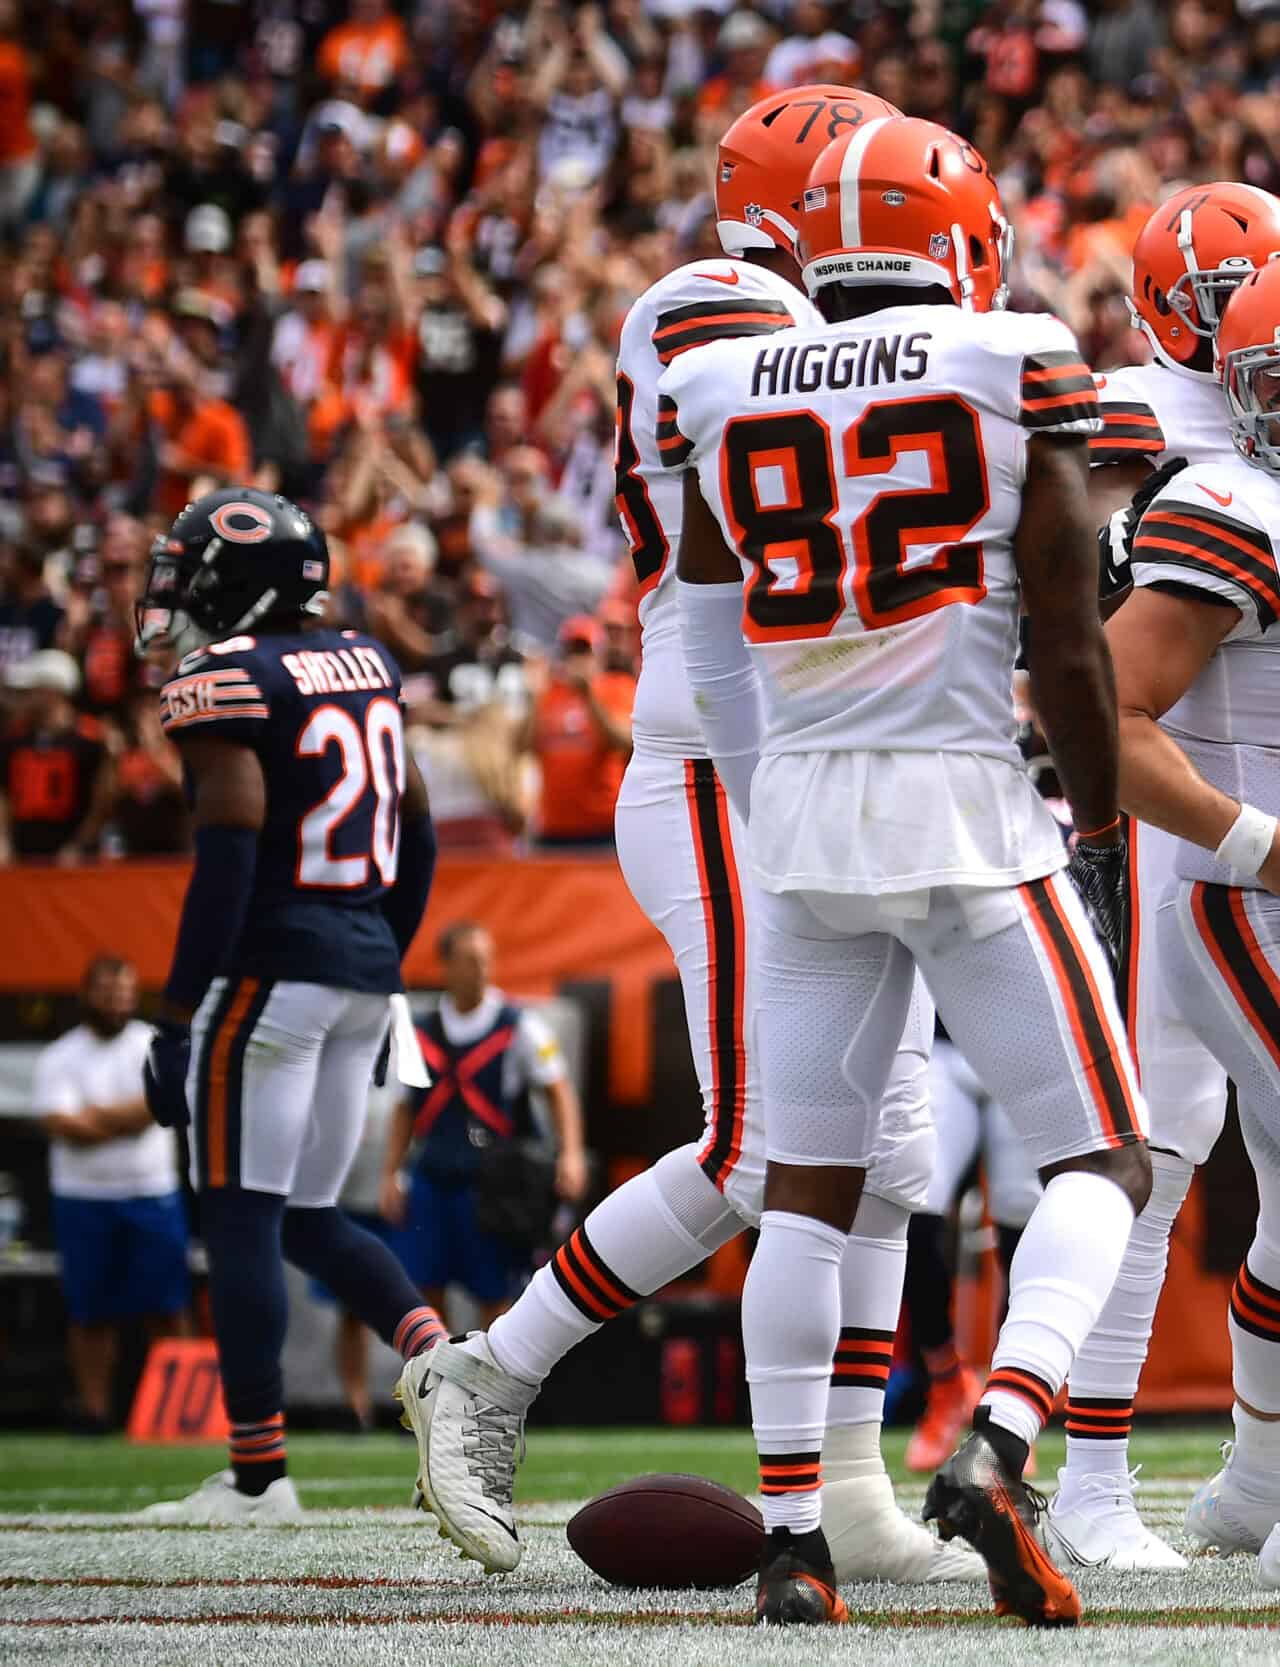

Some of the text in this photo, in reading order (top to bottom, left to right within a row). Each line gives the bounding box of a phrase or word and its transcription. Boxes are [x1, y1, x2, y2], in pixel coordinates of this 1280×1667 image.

[792, 101, 864, 144] 78
[813, 261, 912, 277] INSPIRE CHANGE
[750, 332, 932, 397] HIGGINS
[720, 392, 991, 645] 82
[282, 647, 393, 695] SHELLEY
[166, 680, 215, 719] GSH
[296, 696, 406, 891] 20
[153, 1357, 219, 1434] 10
